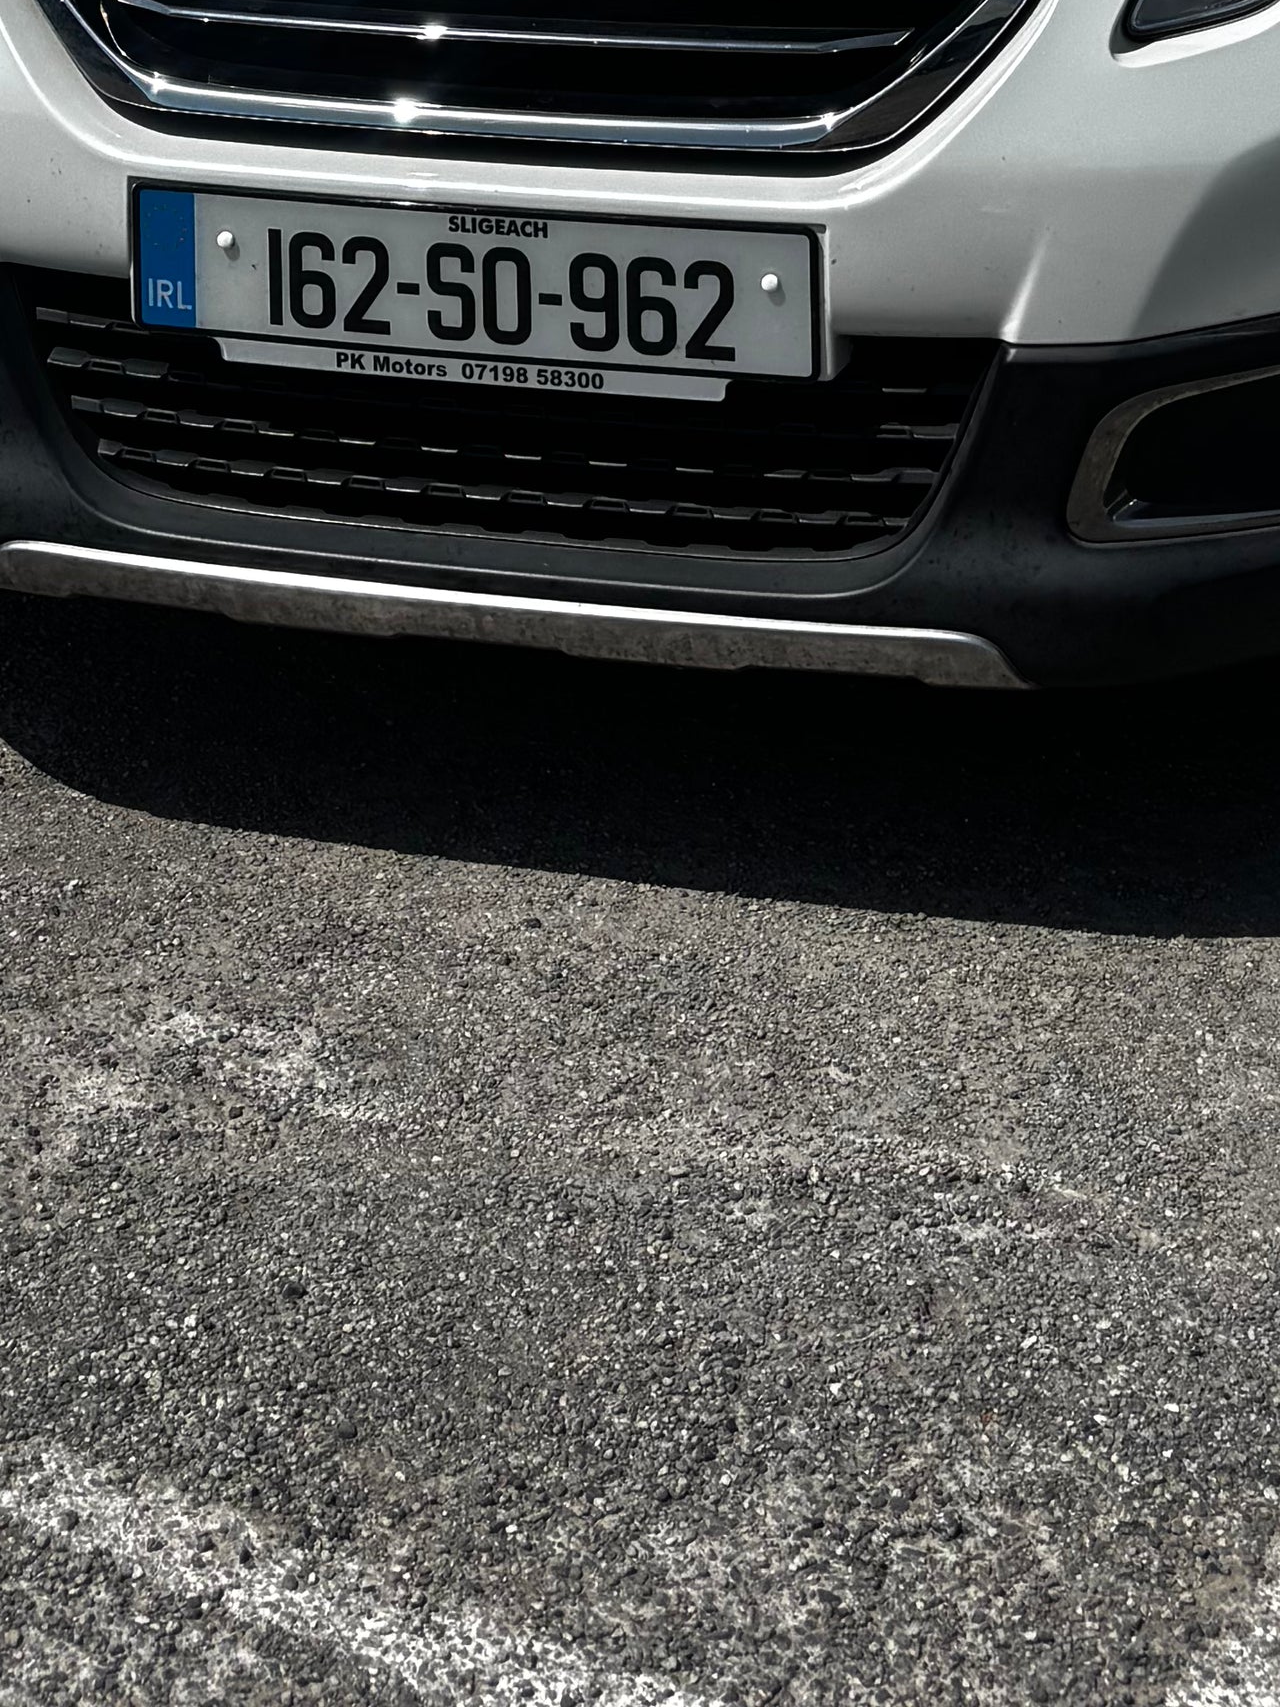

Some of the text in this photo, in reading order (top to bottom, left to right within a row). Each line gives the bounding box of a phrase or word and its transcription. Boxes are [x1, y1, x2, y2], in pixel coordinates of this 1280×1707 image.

[448, 215, 549, 239] SLIGEACH
[147, 277, 193, 312] IRL
[267, 226, 736, 363] 162-SO-962
[336, 351, 605, 390] PK Motors 07198 58300
